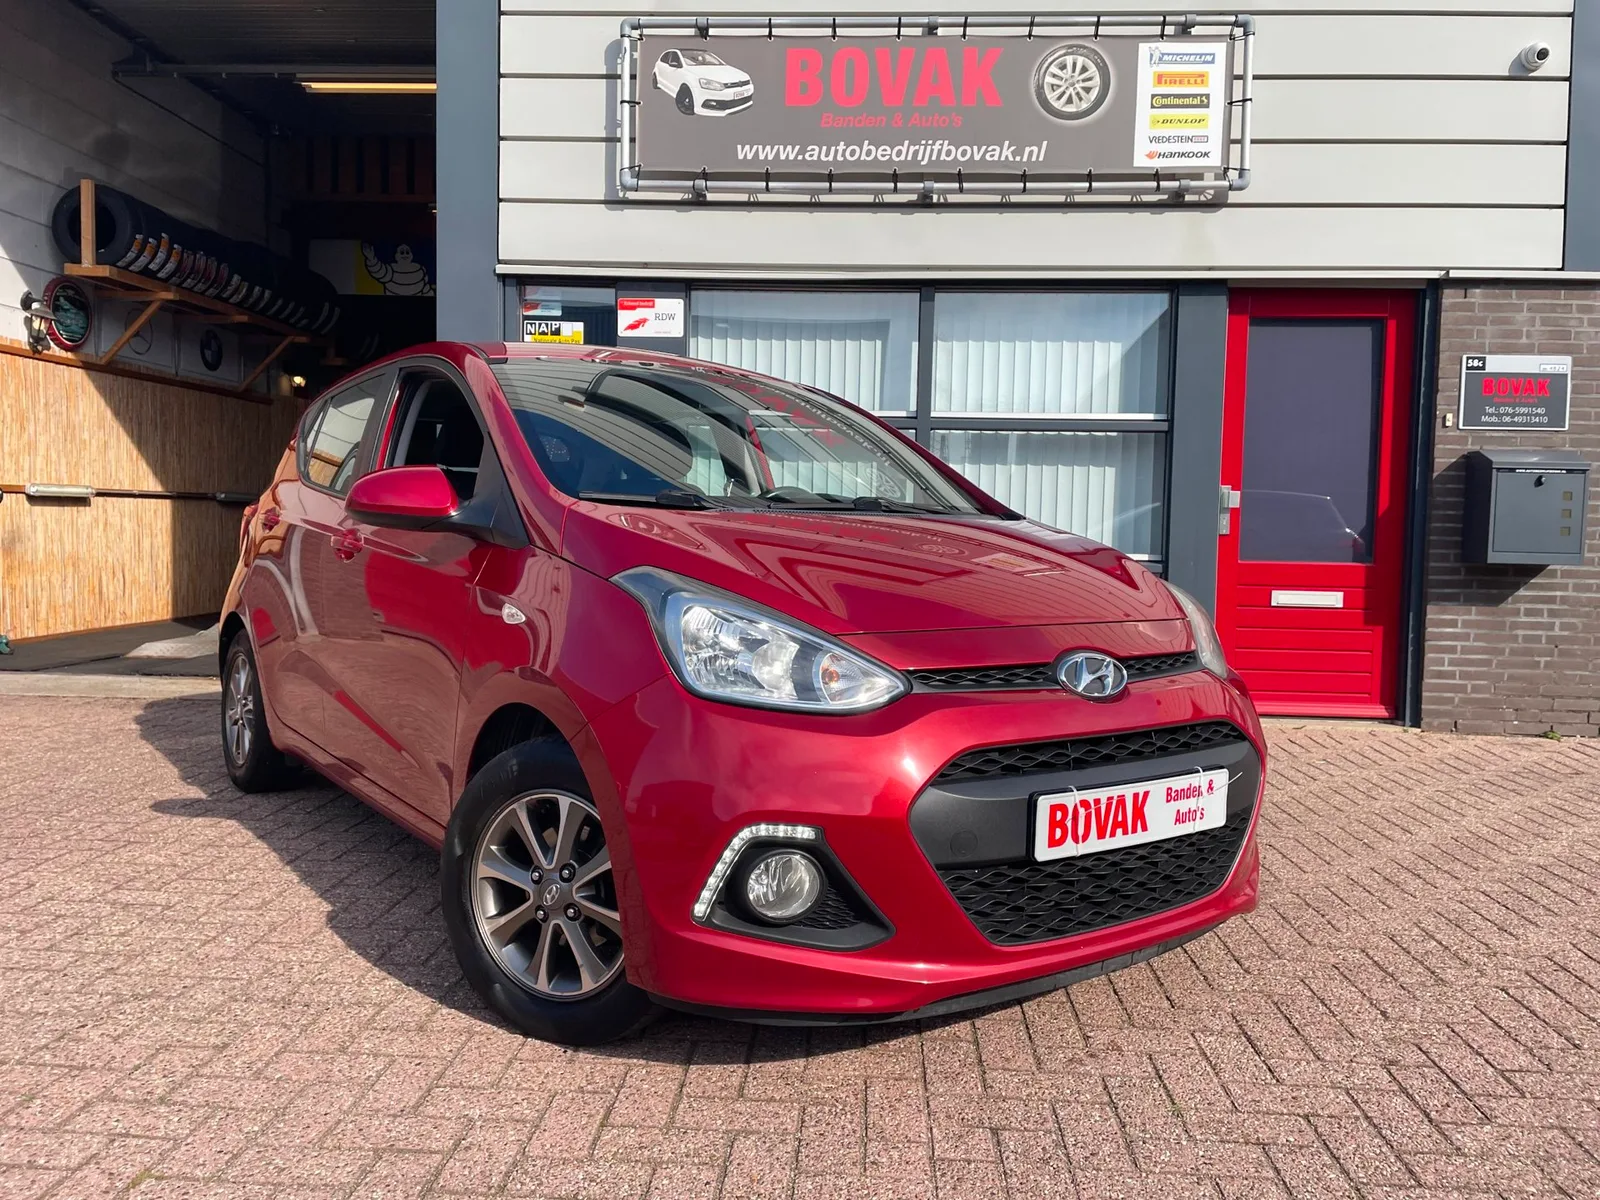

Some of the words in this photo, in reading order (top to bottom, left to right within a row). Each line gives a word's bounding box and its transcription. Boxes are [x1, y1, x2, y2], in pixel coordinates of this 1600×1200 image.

[1162, 54, 1214, 62] MICHELIN
[784, 47, 1005, 107] BOVAK
[1157, 73, 1205, 85] PIRELLI
[1152, 95, 1201, 107] Continental
[820, 112, 887, 128] Banden
[892, 113, 904, 128] &
[908, 112, 963, 128] Auto's
[1148, 135, 1193, 144] VREDESTEIN
[736, 140, 1048, 165] www.autobedrijfbovak.nl
[654, 312, 676, 321] RDW
[526, 322, 560, 334] NAP
[1467, 359, 1484, 367] 58c
[1482, 377, 1550, 397] BOVAK
[1500, 406, 1546, 414] 076-5991540
[1502, 416, 1549, 424] 06-49313410
[1166, 784, 1203, 803] Banden
[1207, 779, 1215, 794] &
[1047, 790, 1150, 849] BOVAK
[1174, 807, 1205, 826] Auto's
